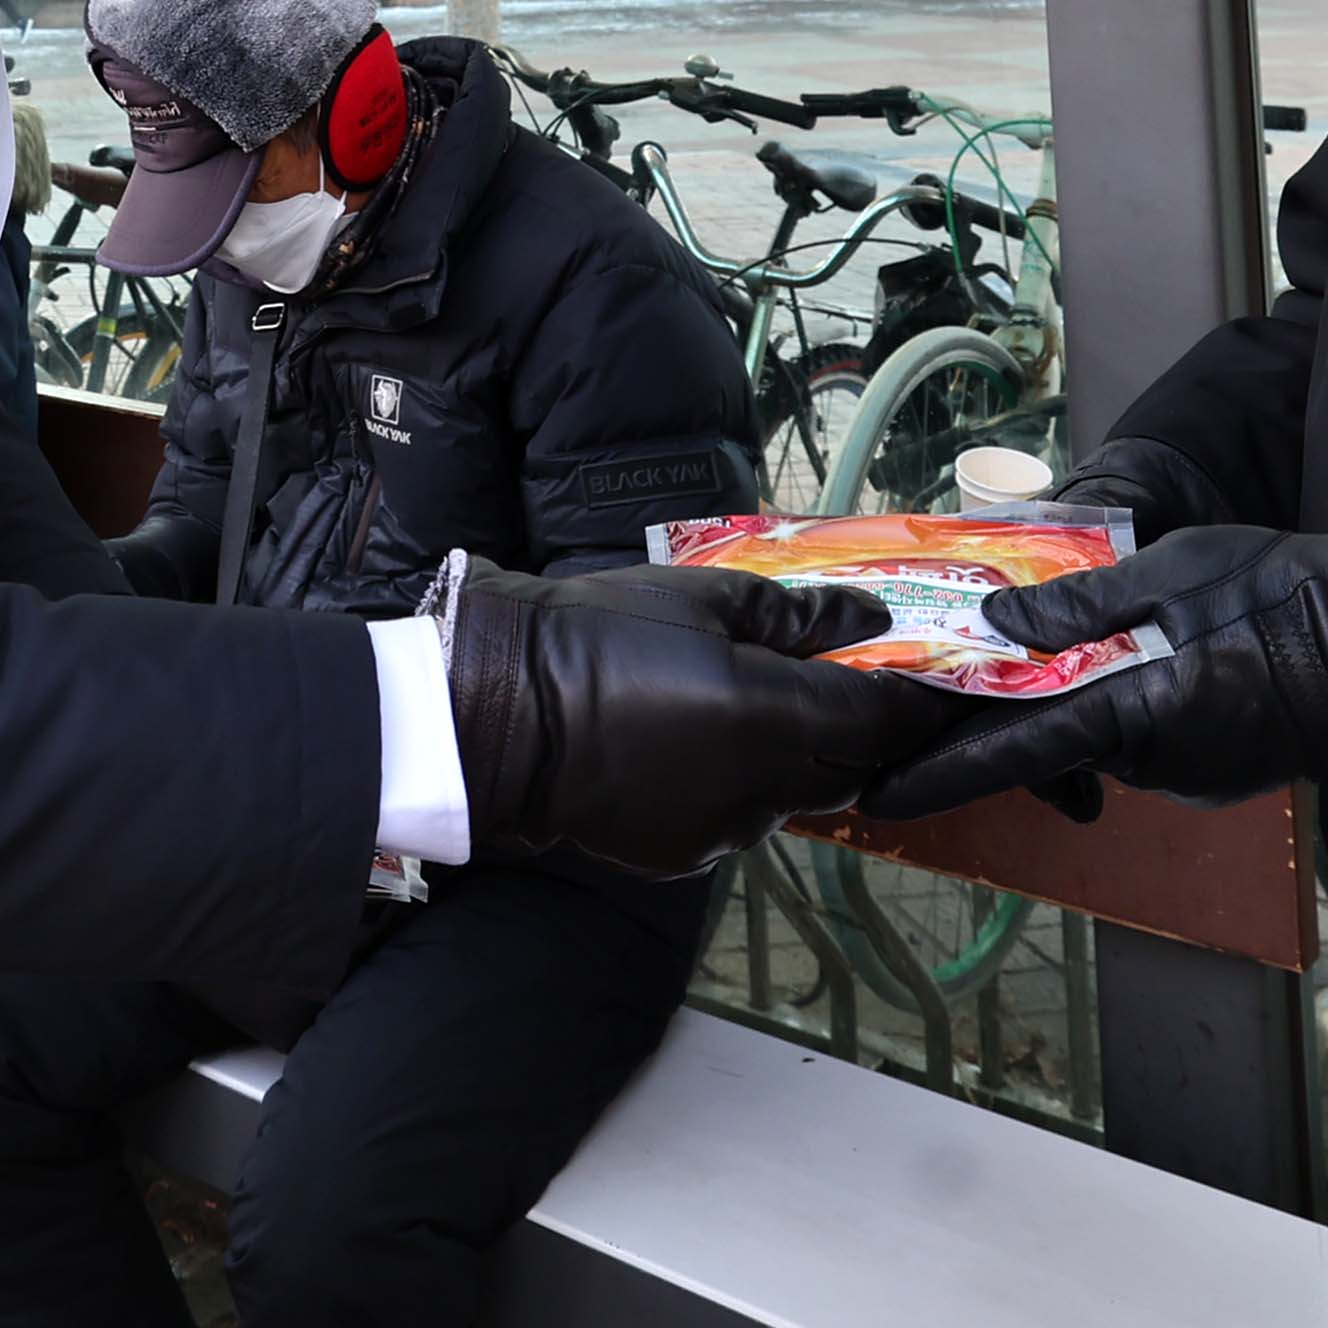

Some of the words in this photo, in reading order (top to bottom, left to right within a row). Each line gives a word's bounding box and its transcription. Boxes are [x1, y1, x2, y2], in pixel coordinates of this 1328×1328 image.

[390, 428, 412, 445] YAK
[590, 467, 663, 495] BLACK
[665, 461, 709, 484] YAK
